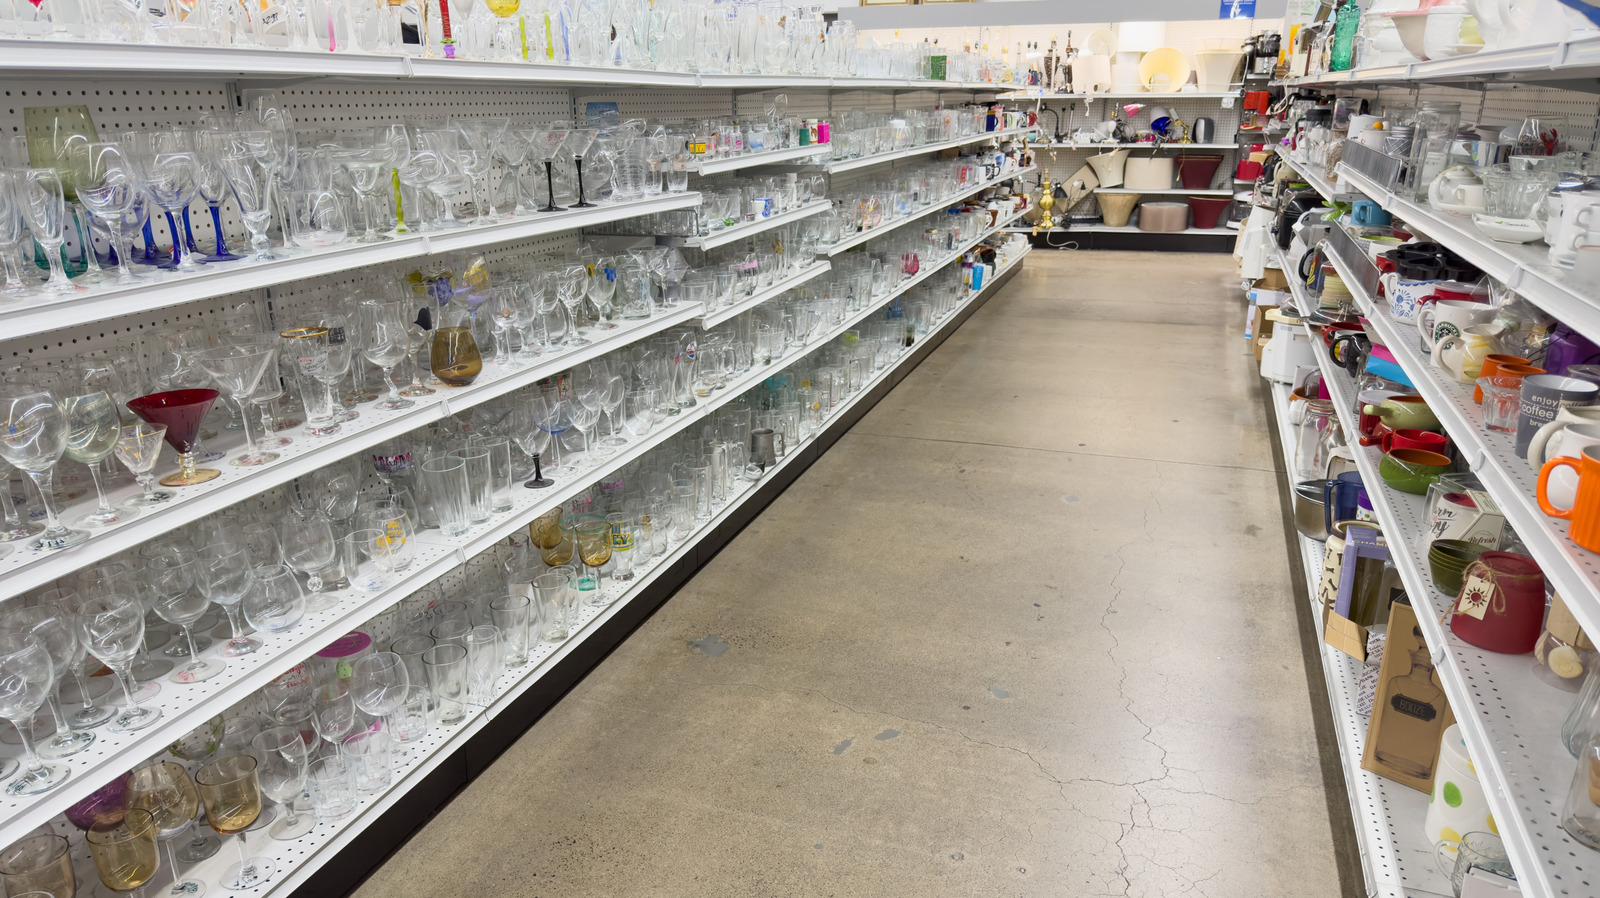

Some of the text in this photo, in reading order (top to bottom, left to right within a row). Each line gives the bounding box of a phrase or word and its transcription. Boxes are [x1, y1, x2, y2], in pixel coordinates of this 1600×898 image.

[1436, 322, 1458, 337] STARBUCKS
[1531, 395, 1558, 407] enjoy
[1521, 404, 1554, 419] coffee
[1529, 419, 1546, 428] bre
[1399, 699, 1426, 716] BOOZE
